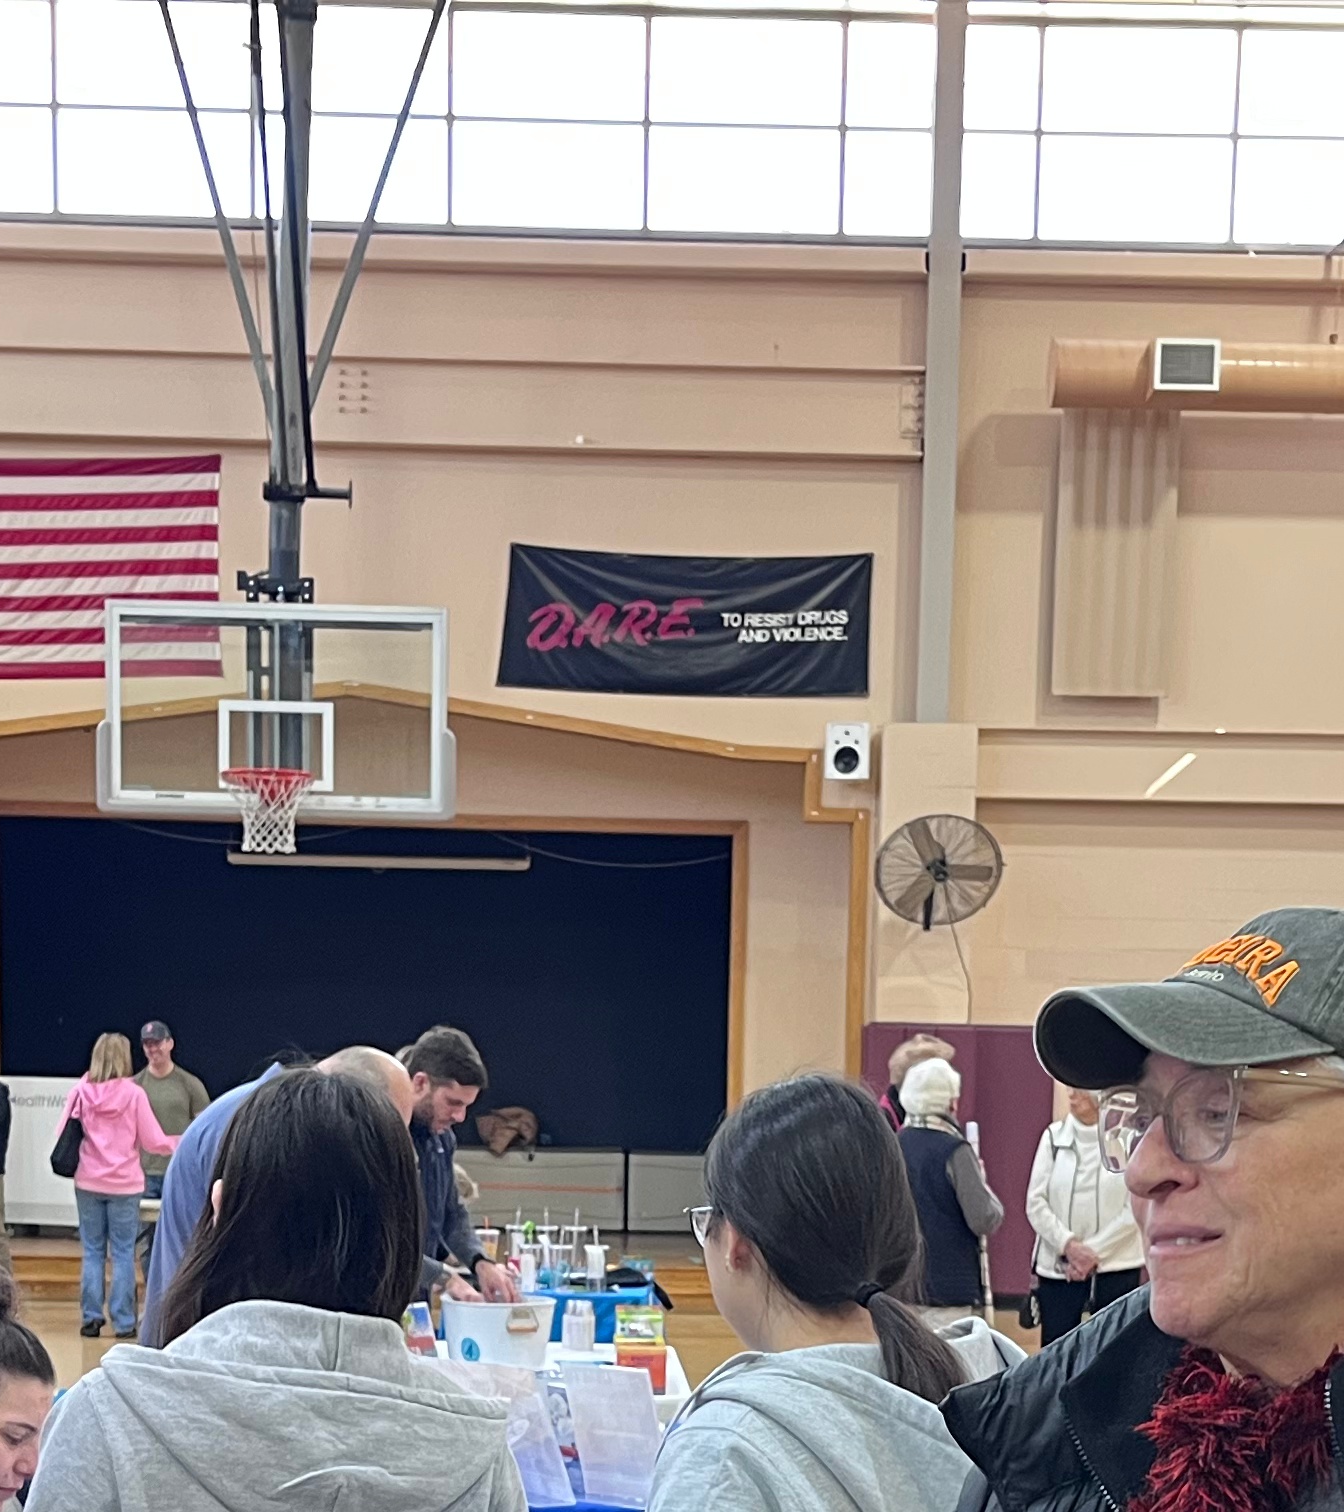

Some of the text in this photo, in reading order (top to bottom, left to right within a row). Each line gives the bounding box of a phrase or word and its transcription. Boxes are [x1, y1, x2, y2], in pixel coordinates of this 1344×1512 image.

[720, 609, 849, 628] TO RESIST DRUGS
[737, 626, 849, 643] AND VIOLENCE.
